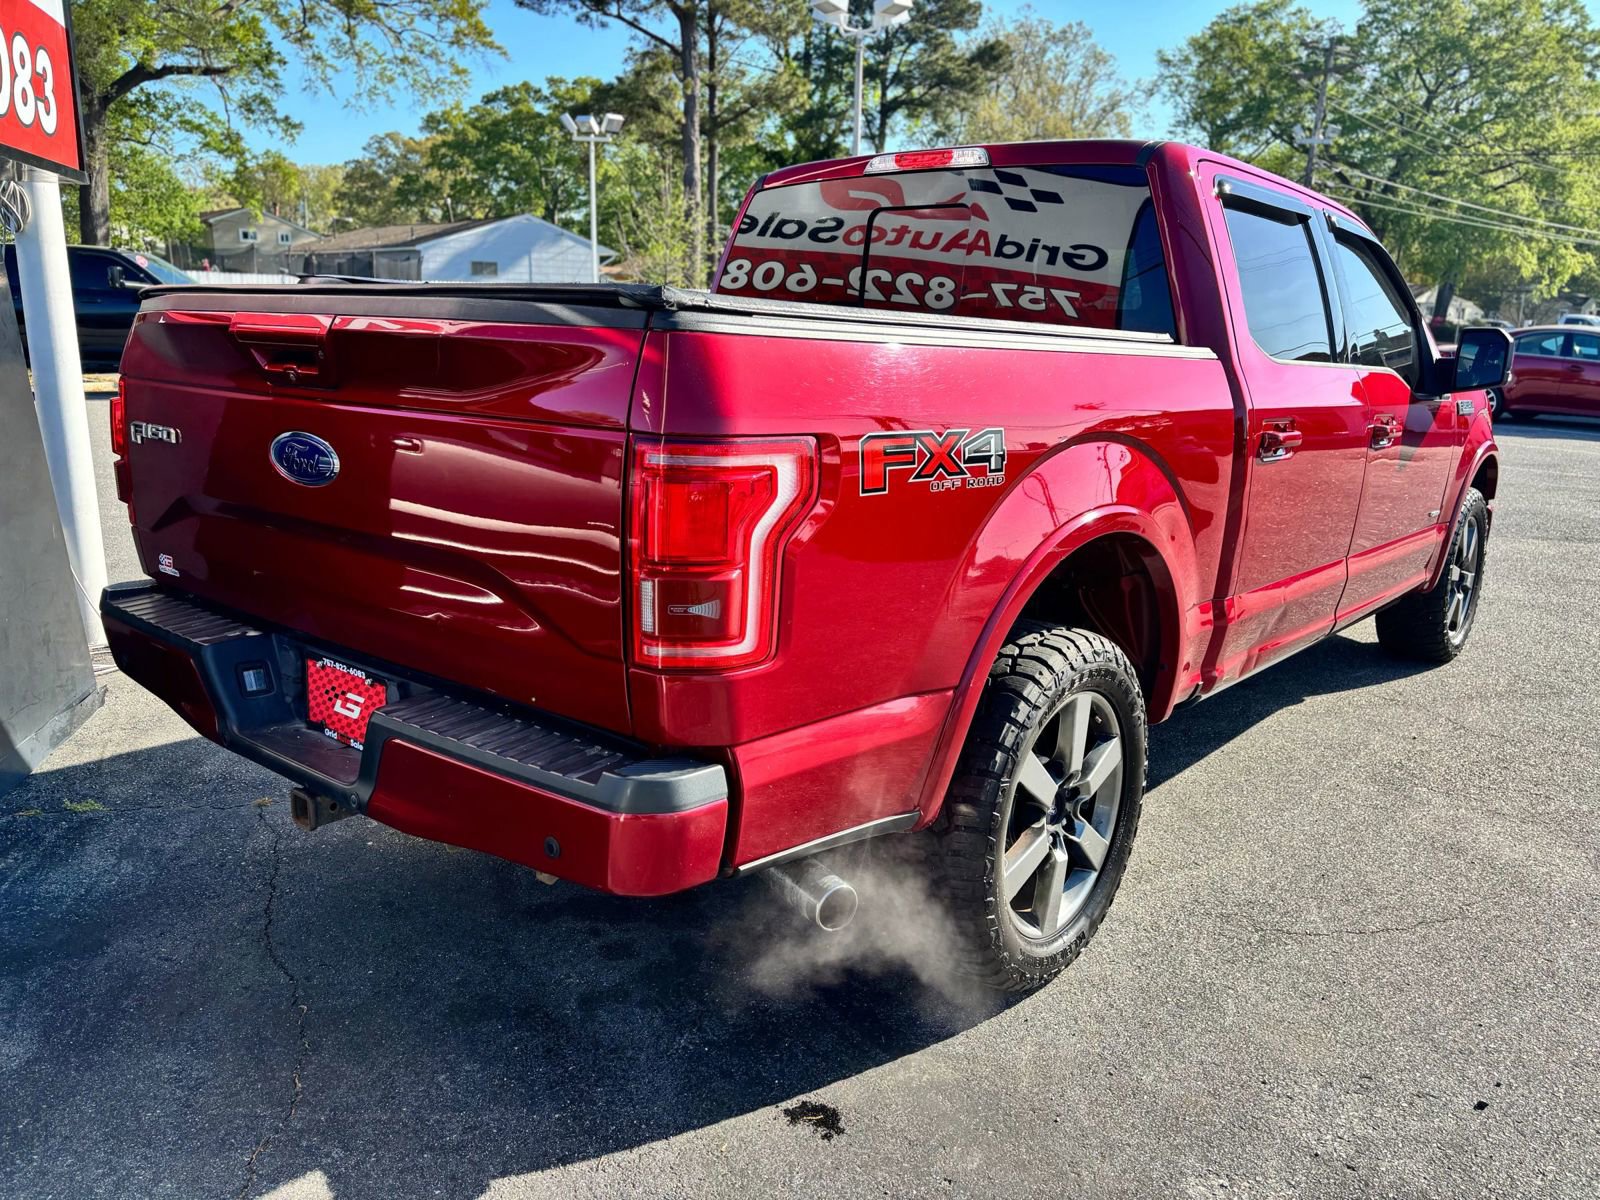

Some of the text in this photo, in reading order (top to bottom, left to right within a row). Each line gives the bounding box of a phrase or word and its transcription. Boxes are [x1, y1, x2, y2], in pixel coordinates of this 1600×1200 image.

[282, 442, 319, 475] Ford
[859, 428, 1007, 496] FX4
[930, 475, 1006, 492] OFF ROAD
